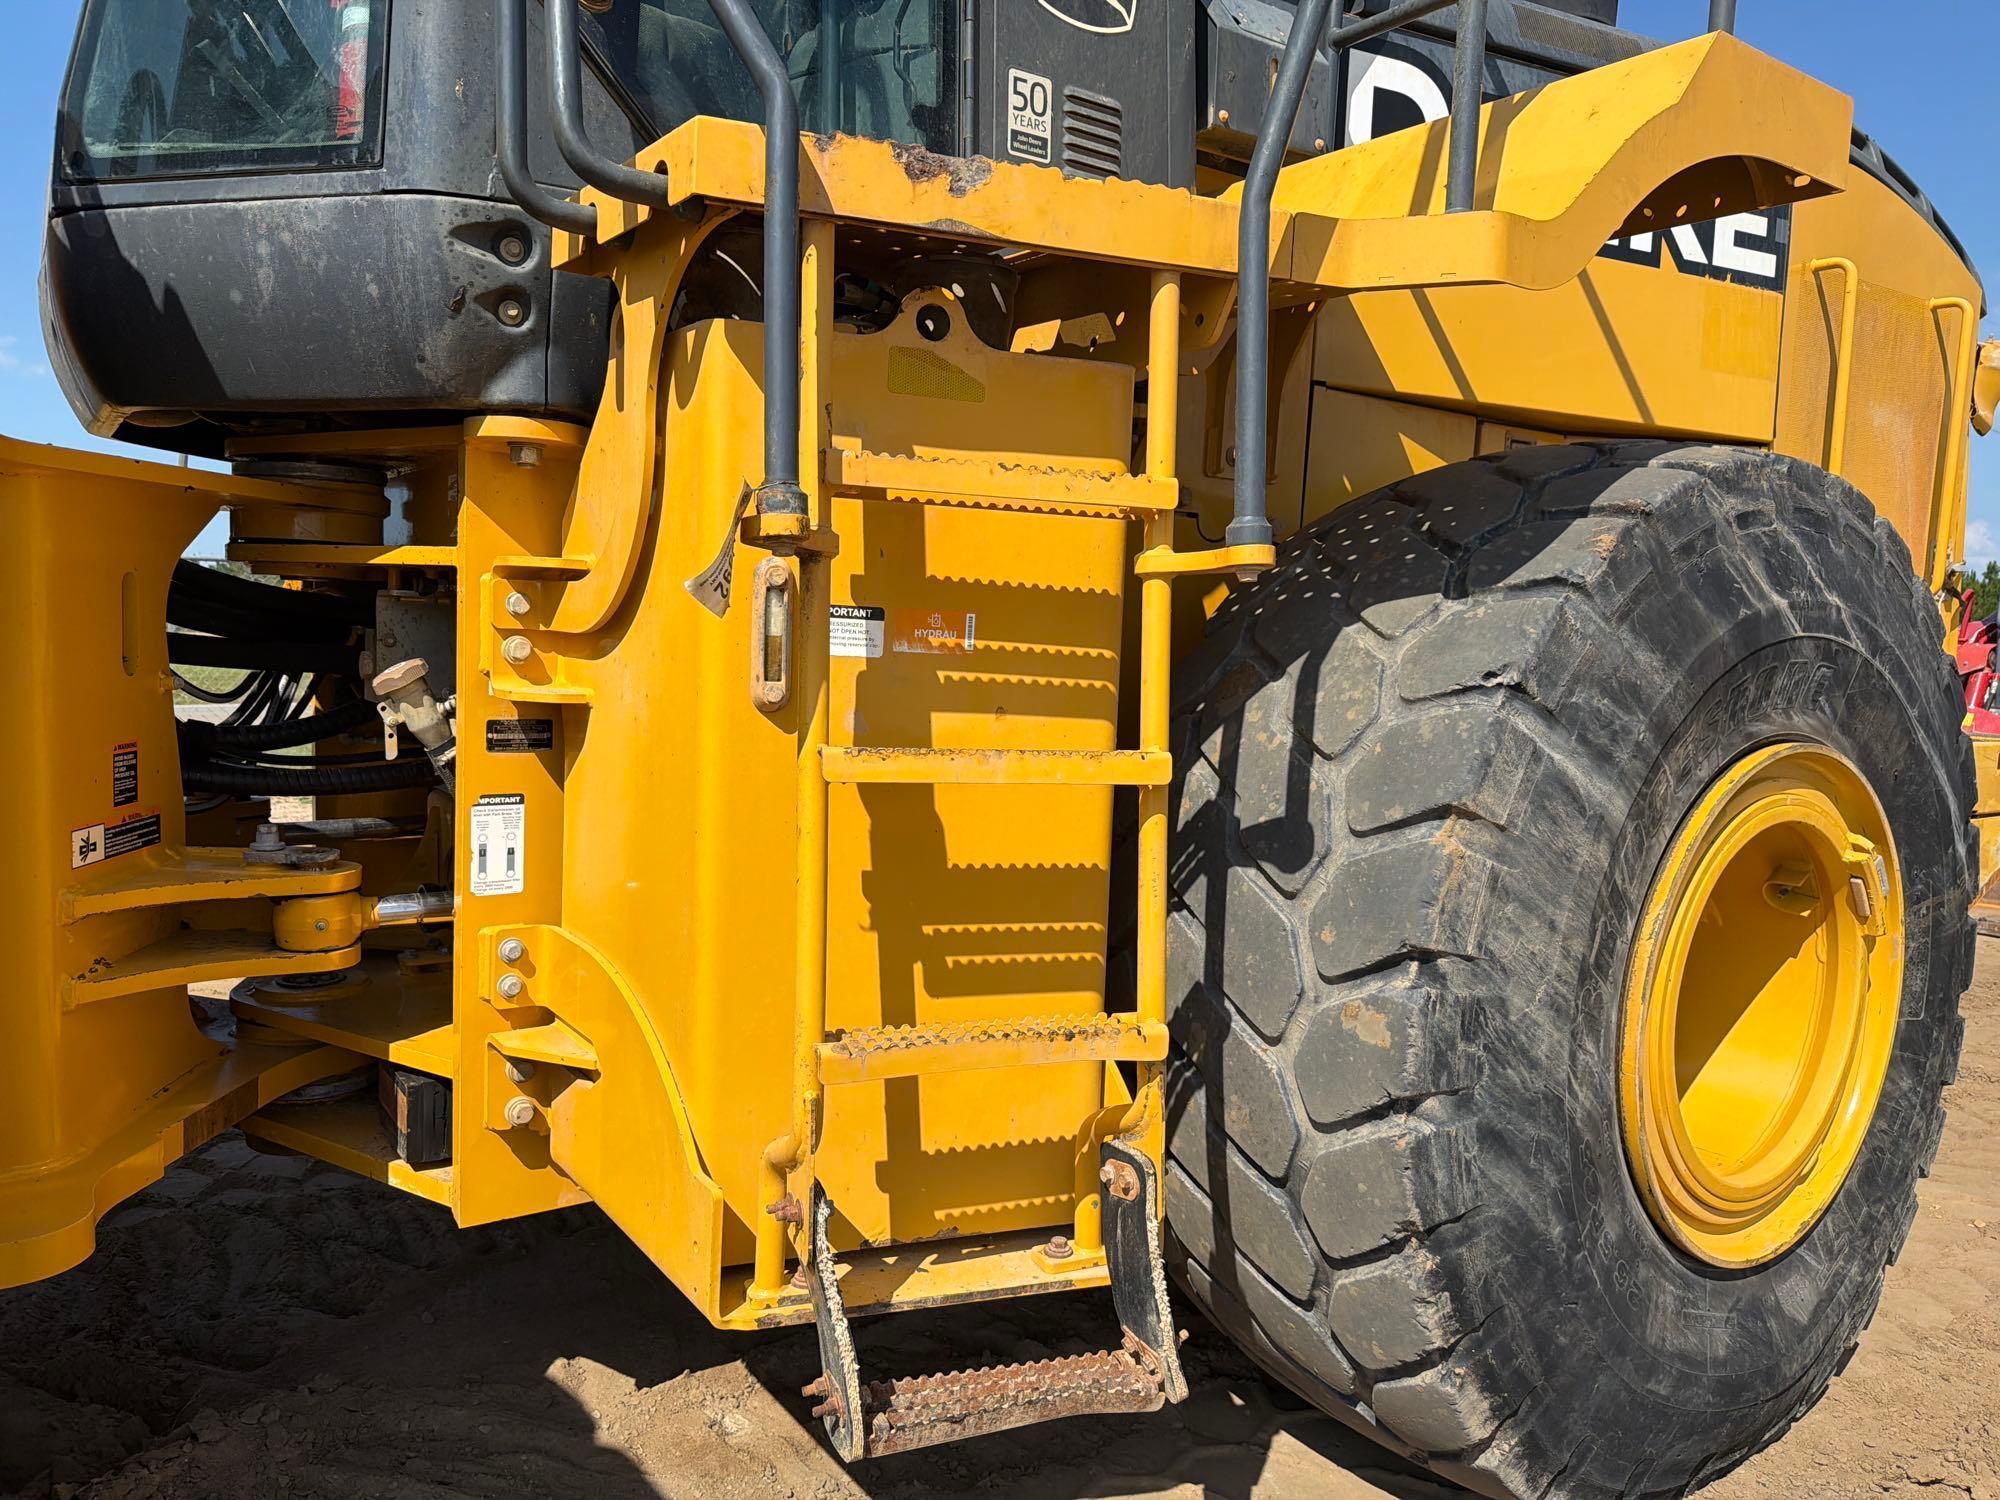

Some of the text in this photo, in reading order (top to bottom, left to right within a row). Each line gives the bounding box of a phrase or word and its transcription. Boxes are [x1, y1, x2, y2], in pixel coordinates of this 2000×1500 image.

[1012, 75, 1048, 118] 50
[1012, 112, 1047, 133] YEARS
[830, 606, 873, 618] PORTANT
[479, 796, 522, 804] MPORTANT
